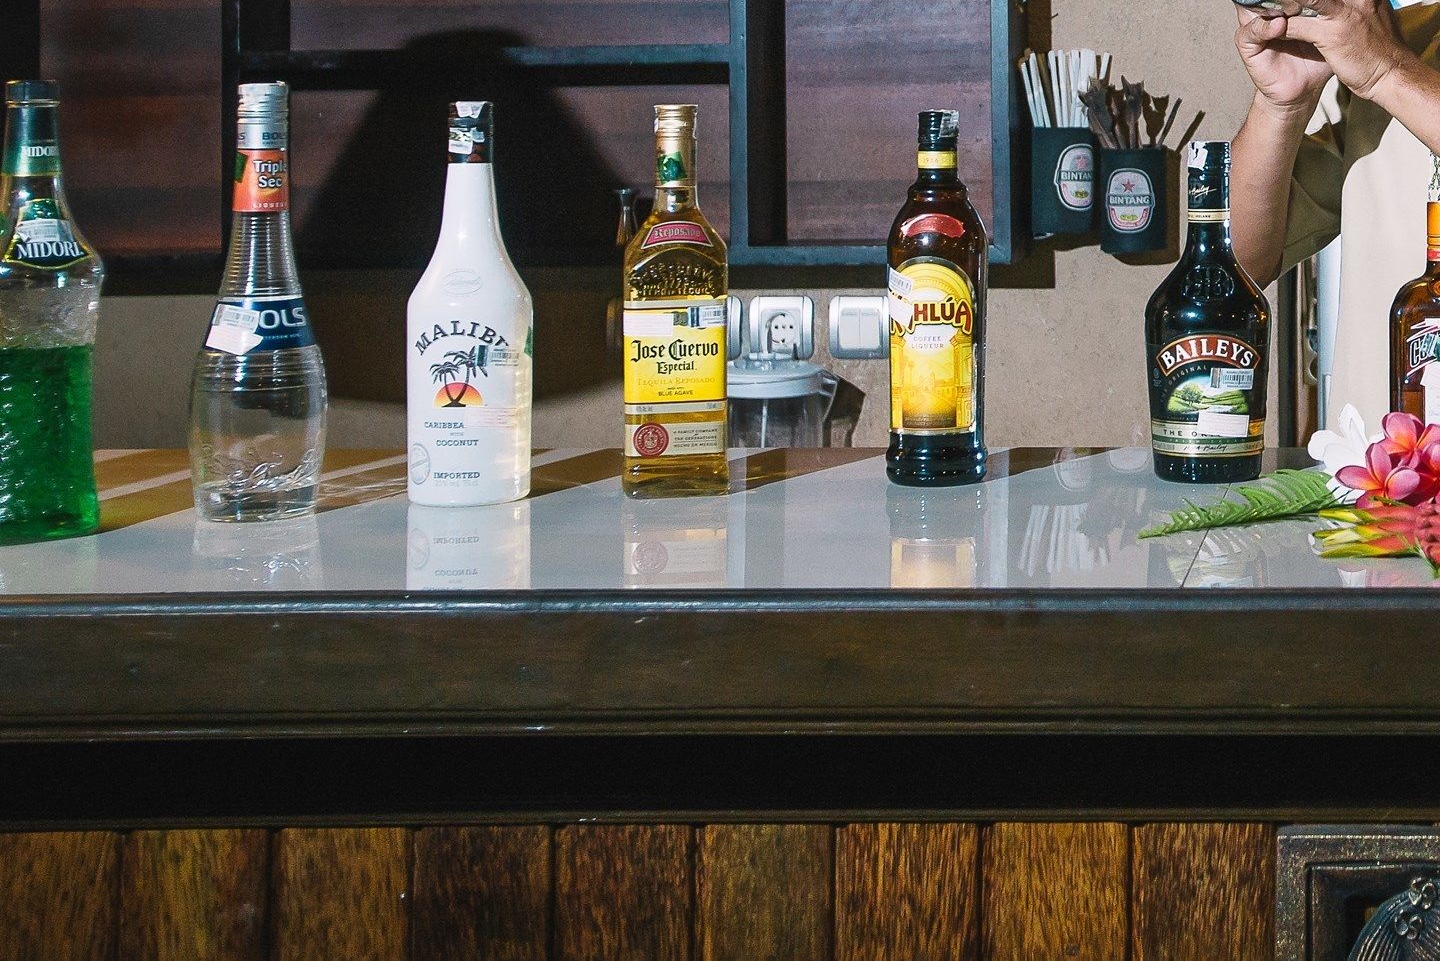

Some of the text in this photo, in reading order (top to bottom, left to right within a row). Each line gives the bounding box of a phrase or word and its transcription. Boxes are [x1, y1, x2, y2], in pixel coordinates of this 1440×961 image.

[262, 132, 286, 140] BOL
[21, 145, 60, 157] MIDOR
[258, 175, 283, 188] Sec
[1061, 172, 1092, 181] BINTAN
[1109, 195, 1150, 204] BINTANG
[654, 228, 702, 238] Reposado
[16, 241, 81, 260] MIDORI
[259, 307, 307, 329] OLS
[631, 339, 719, 362] Jose Cuervo
[1161, 338, 1254, 370] BAILEYS
[656, 361, 695, 375] Especial
[1168, 365, 1207, 385] ORIGINAL
[638, 377, 716, 387] TEQUILA REPOSADO
[424, 421, 465, 429] CARIBBEA
[436, 439, 479, 447] COCONUT
[433, 471, 481, 479] IMPORTED
